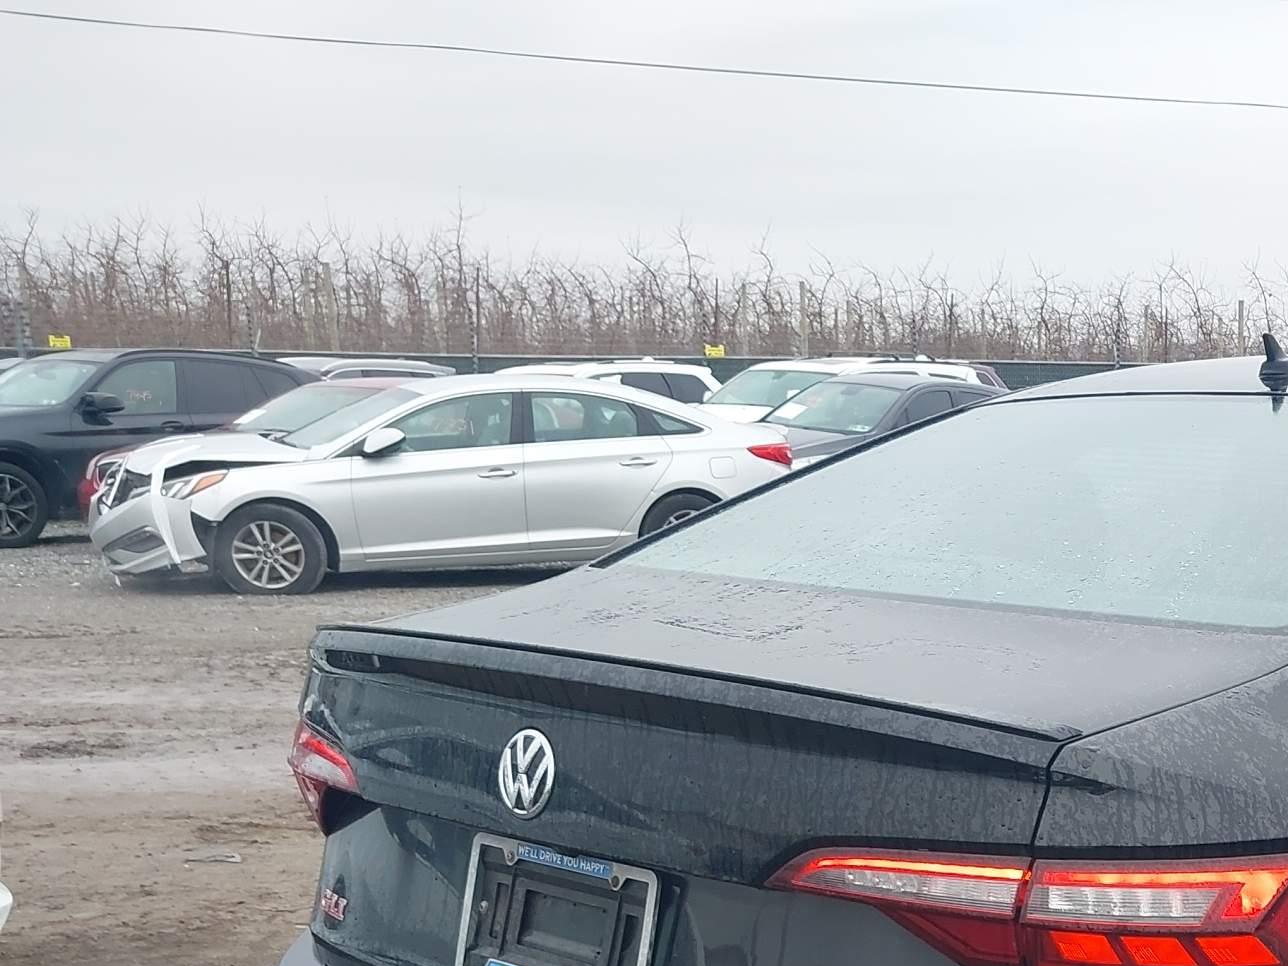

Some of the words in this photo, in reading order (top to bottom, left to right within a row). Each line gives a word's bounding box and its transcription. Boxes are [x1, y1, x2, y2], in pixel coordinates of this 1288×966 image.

[539, 850, 562, 865] DRIVE
[562, 855, 579, 868] YOU
[580, 859, 605, 874] HAPPY
